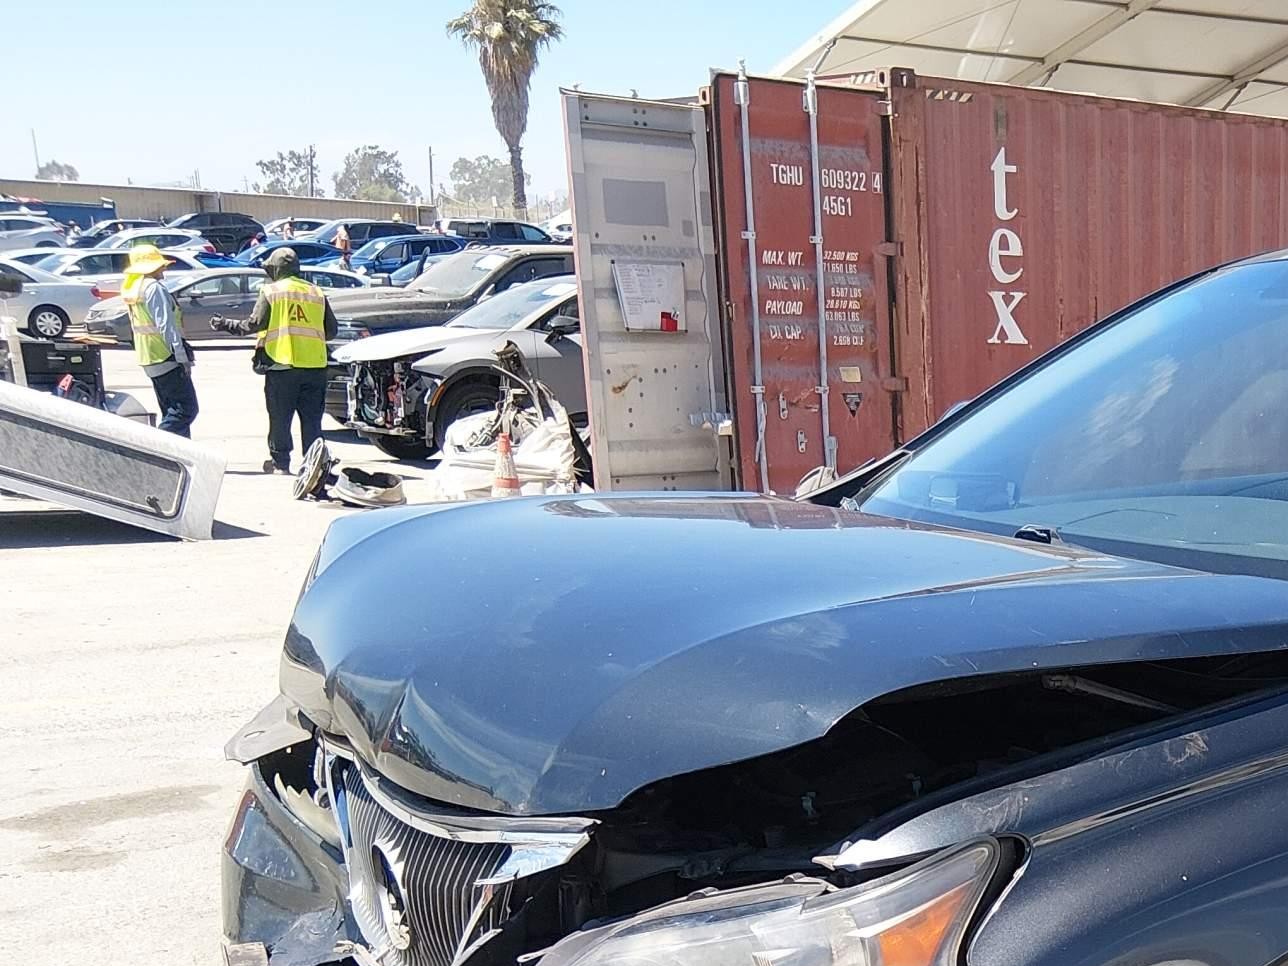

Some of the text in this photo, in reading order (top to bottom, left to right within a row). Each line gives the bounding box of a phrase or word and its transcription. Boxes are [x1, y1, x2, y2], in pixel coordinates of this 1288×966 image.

[770, 164, 803, 185] TGHU
[821, 169, 866, 191] 609322
[822, 196, 852, 216] 45G1
[987, 147, 1028, 344] tex
[762, 250, 785, 265] MAX.
[788, 251, 805, 266] WT.
[765, 300, 803, 315] PAYLOAD
